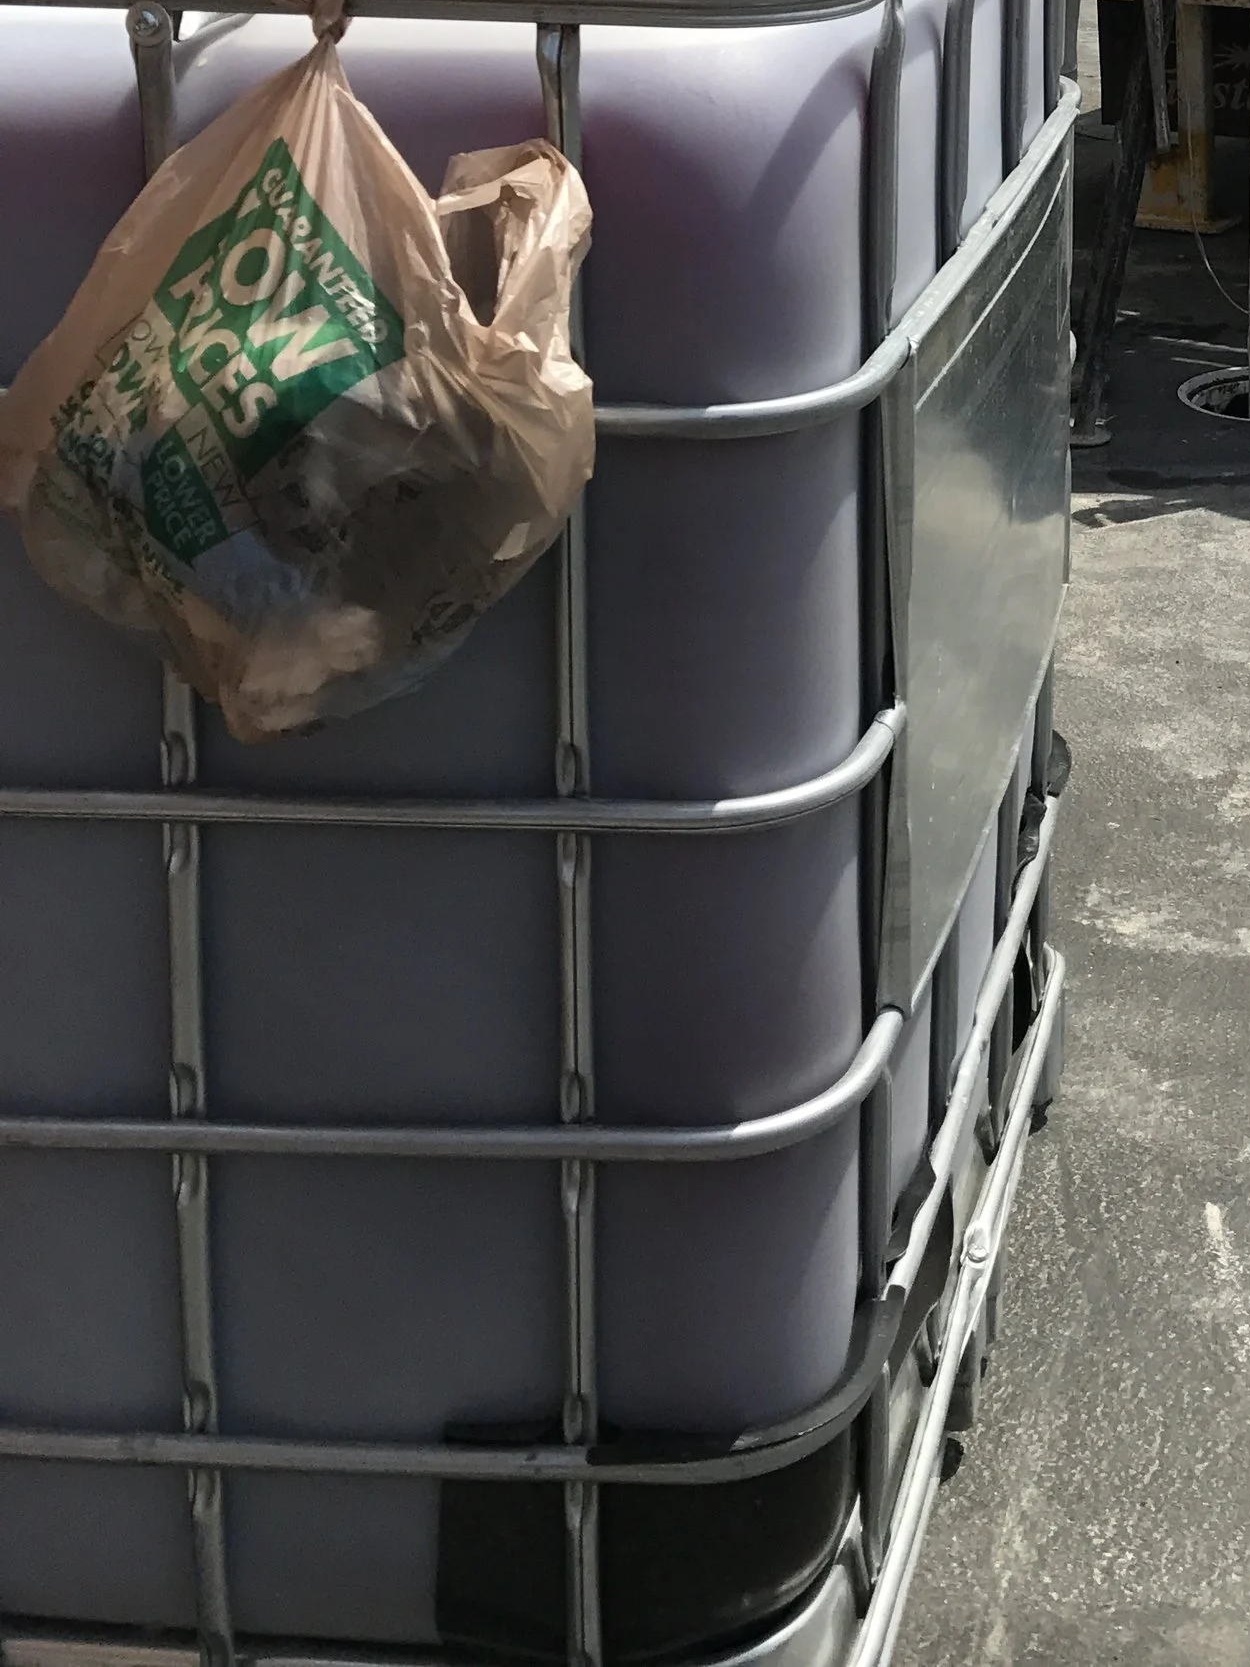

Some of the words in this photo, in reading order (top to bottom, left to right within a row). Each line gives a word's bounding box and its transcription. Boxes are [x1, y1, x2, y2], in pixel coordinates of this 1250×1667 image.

[216, 186, 361, 382] OW
[260, 166, 391, 348] GUARANTEED
[146, 468, 190, 551] PRICE
[155, 440, 218, 544] LOWER
[186, 424, 241, 509] NEW
